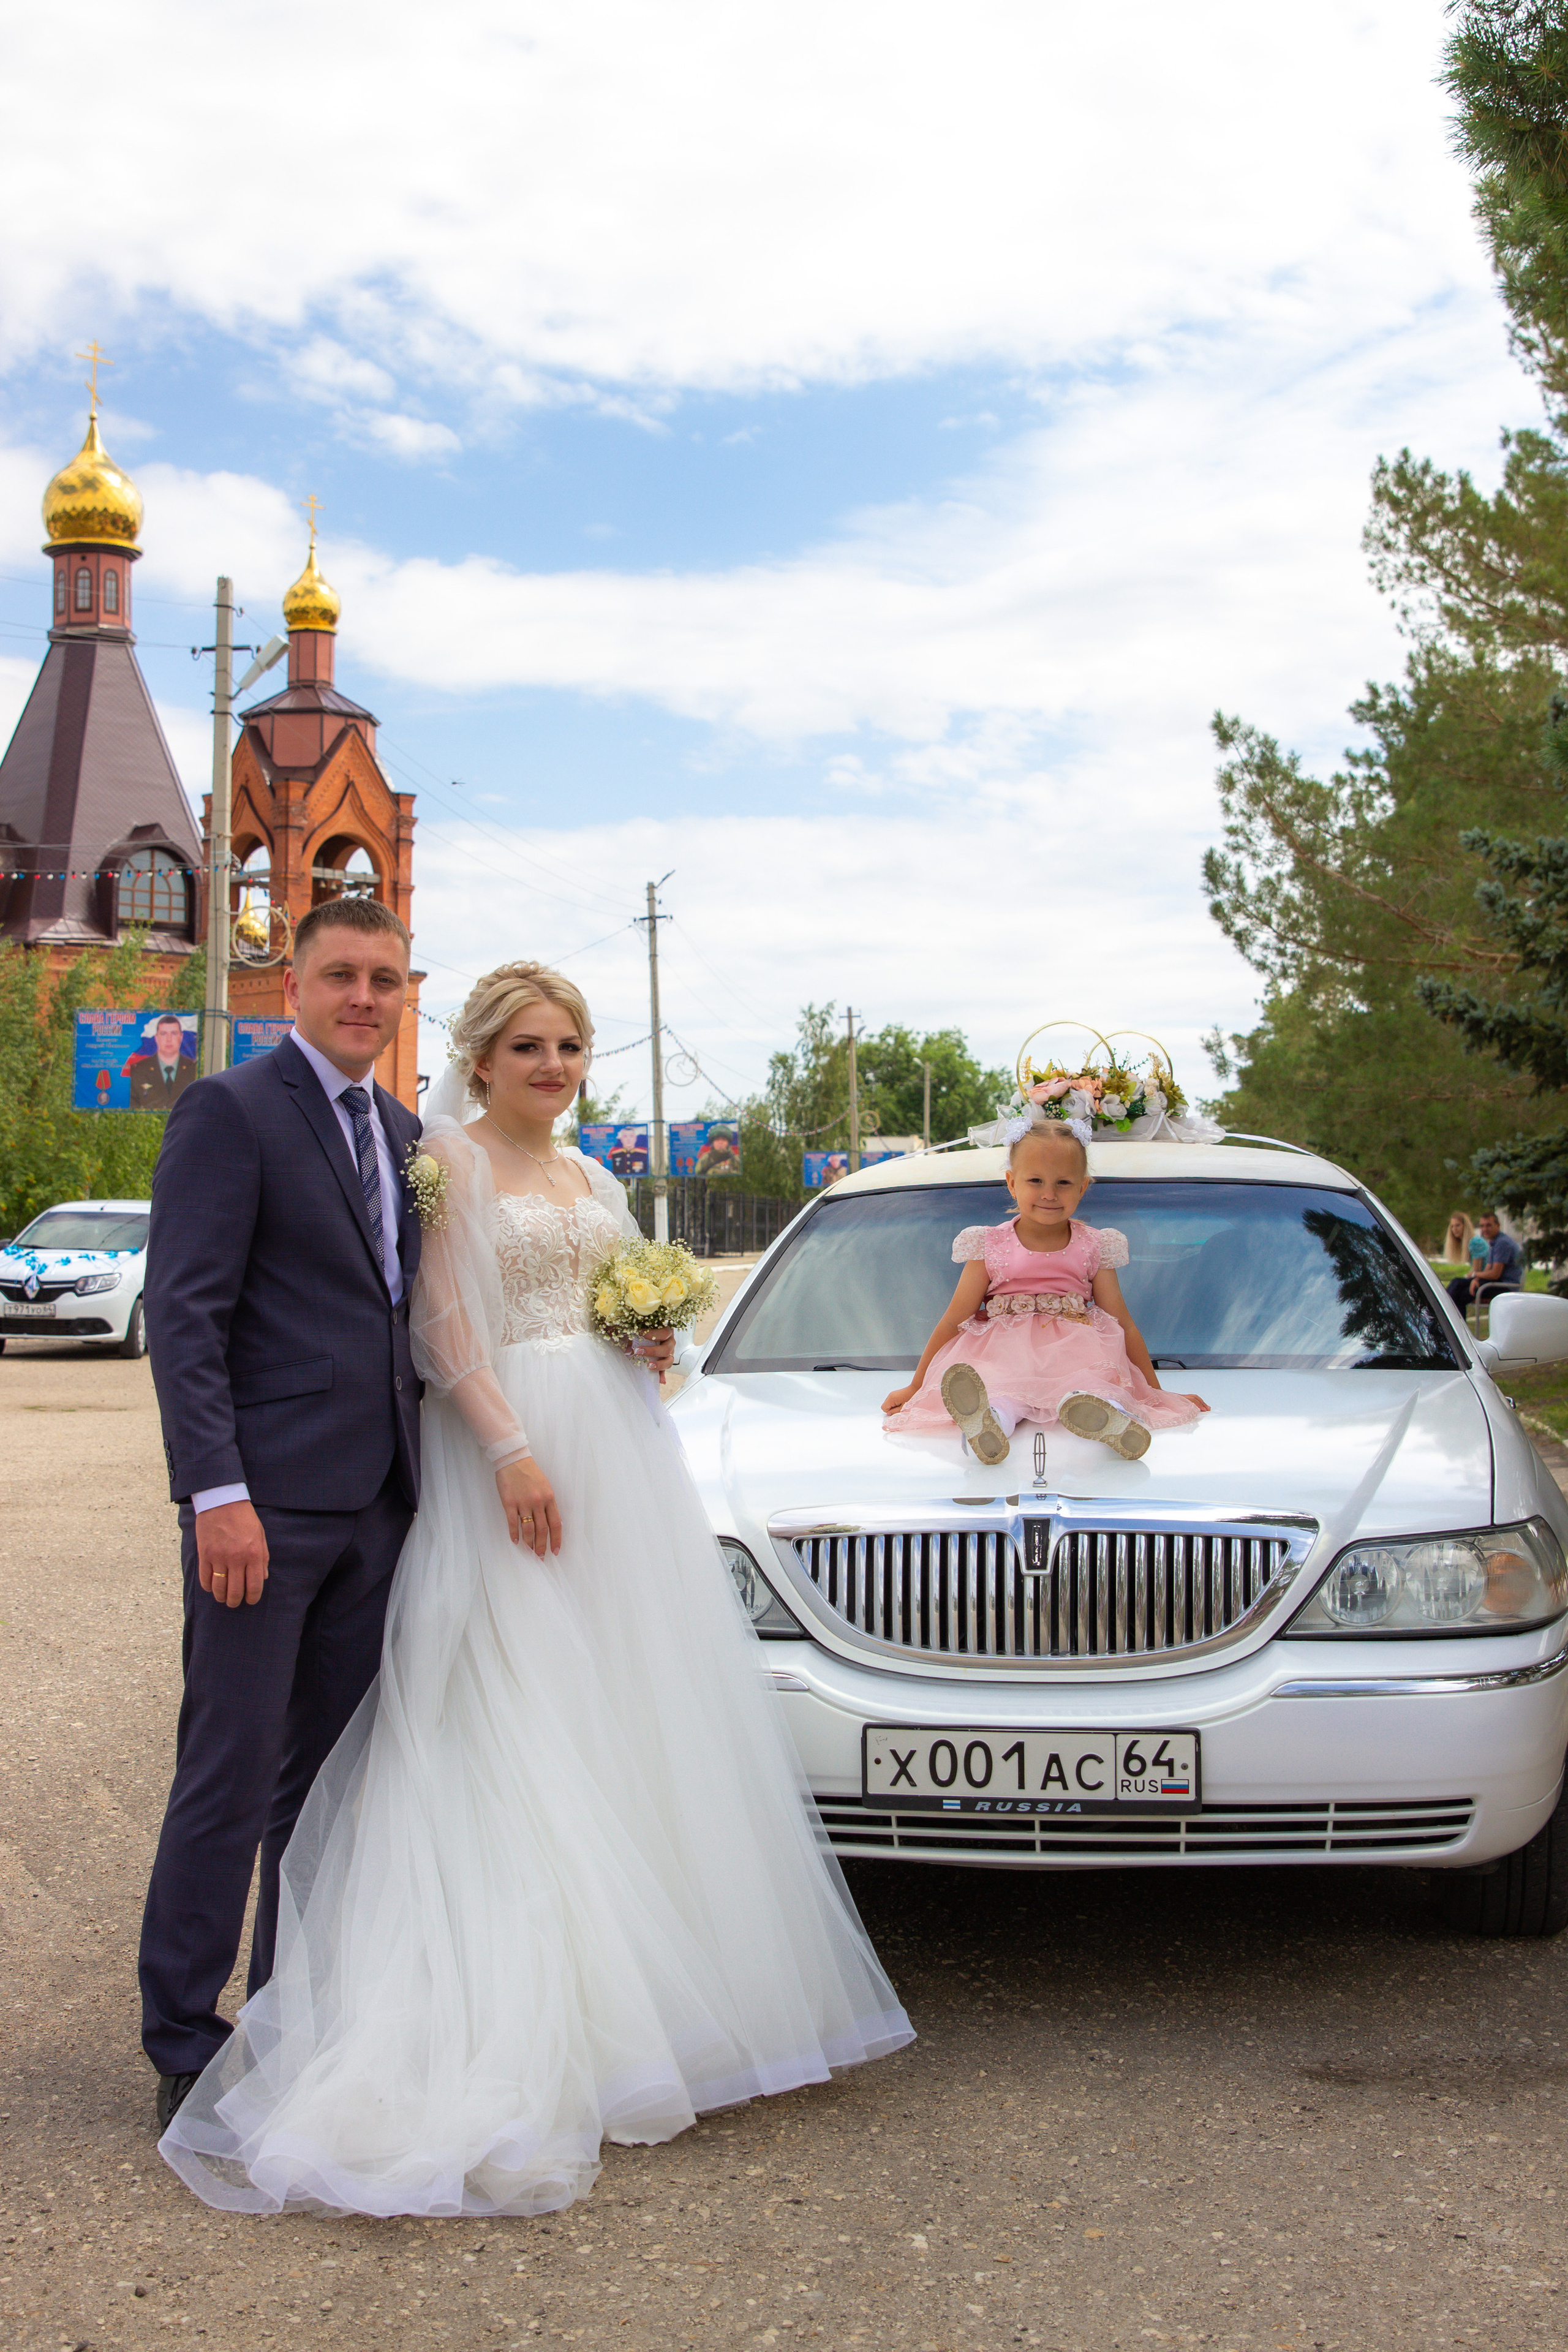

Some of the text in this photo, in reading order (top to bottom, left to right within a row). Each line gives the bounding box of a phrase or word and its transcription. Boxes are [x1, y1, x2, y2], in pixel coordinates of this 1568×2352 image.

[79, 1012, 136, 1024] СЛАВА ГЕРОЯМ
[92, 1024, 122, 1036] РОССИИ
[238, 1022, 264, 1034] СЛАВА
[1123, 1740, 1174, 1777] 64
[1120, 1779, 1159, 1793] RUS
[974, 1801, 1082, 1814] RUSSIA
